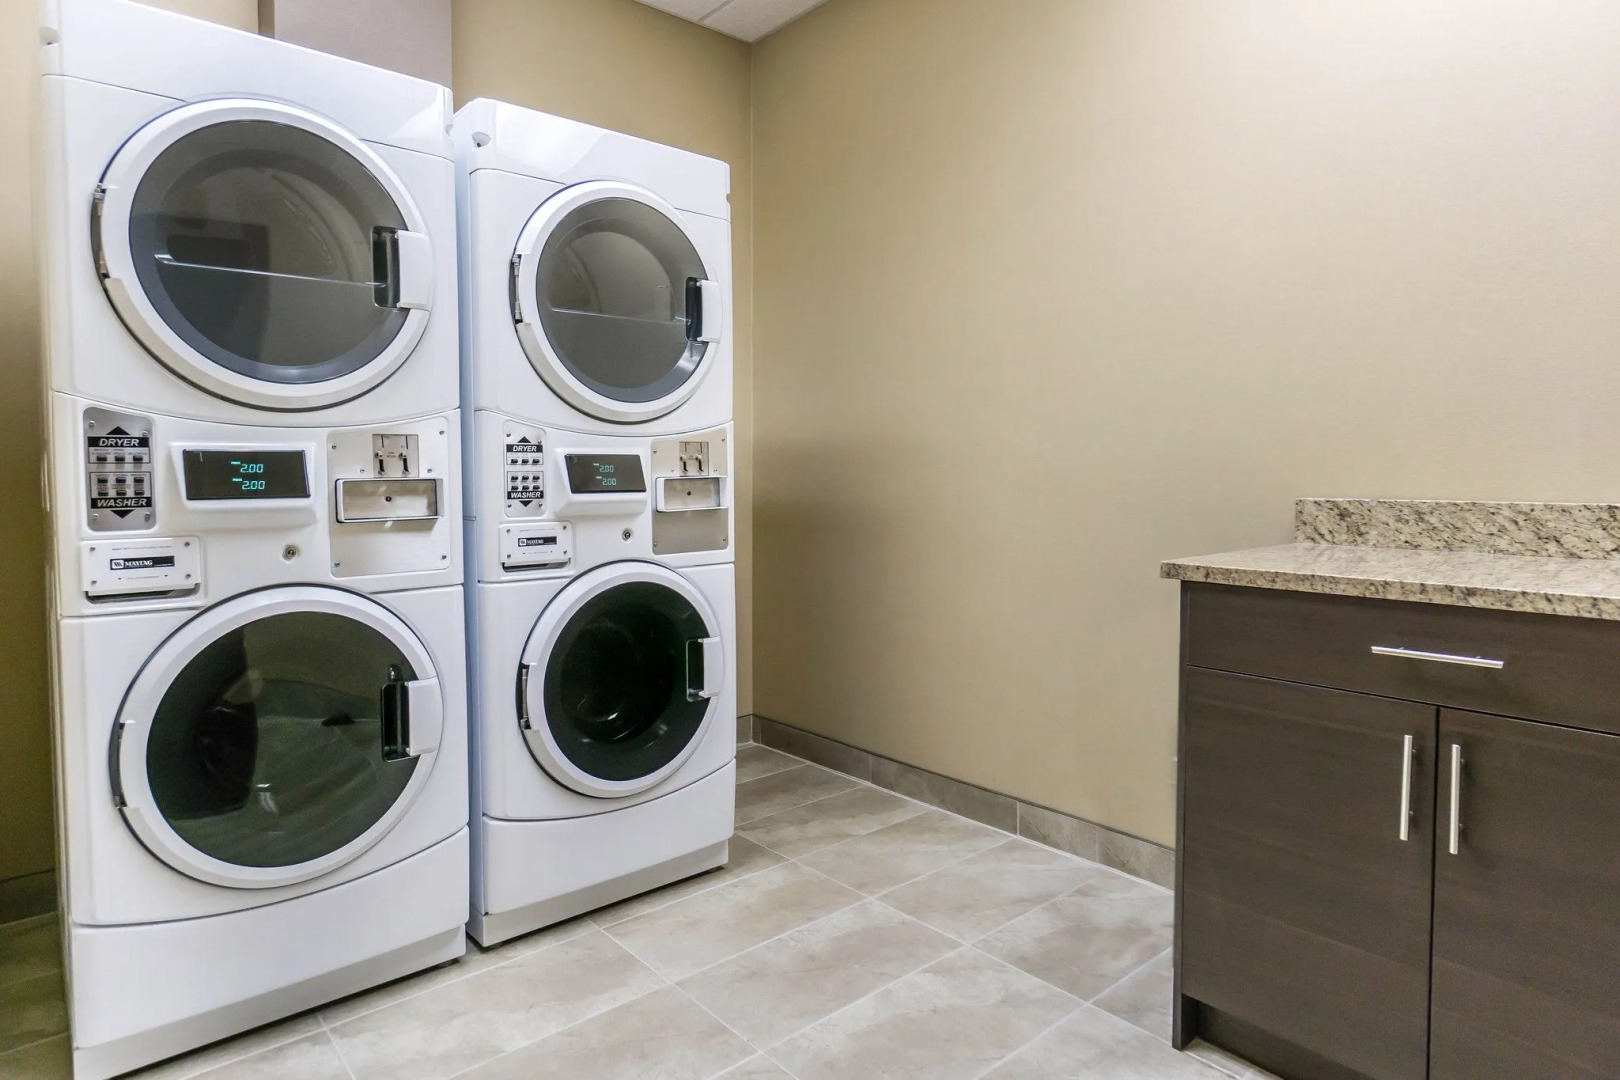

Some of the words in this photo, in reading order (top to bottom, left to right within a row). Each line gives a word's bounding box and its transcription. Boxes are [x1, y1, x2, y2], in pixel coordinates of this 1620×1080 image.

[99, 438, 140, 447] DRYER
[240, 463, 264, 473] 2.00
[600, 465, 614, 473] 2.00
[241, 480, 266, 490] 2.00
[602, 478, 617, 486] 2.00
[511, 491, 541, 499] WASHER
[97, 498, 147, 507] WASHER
